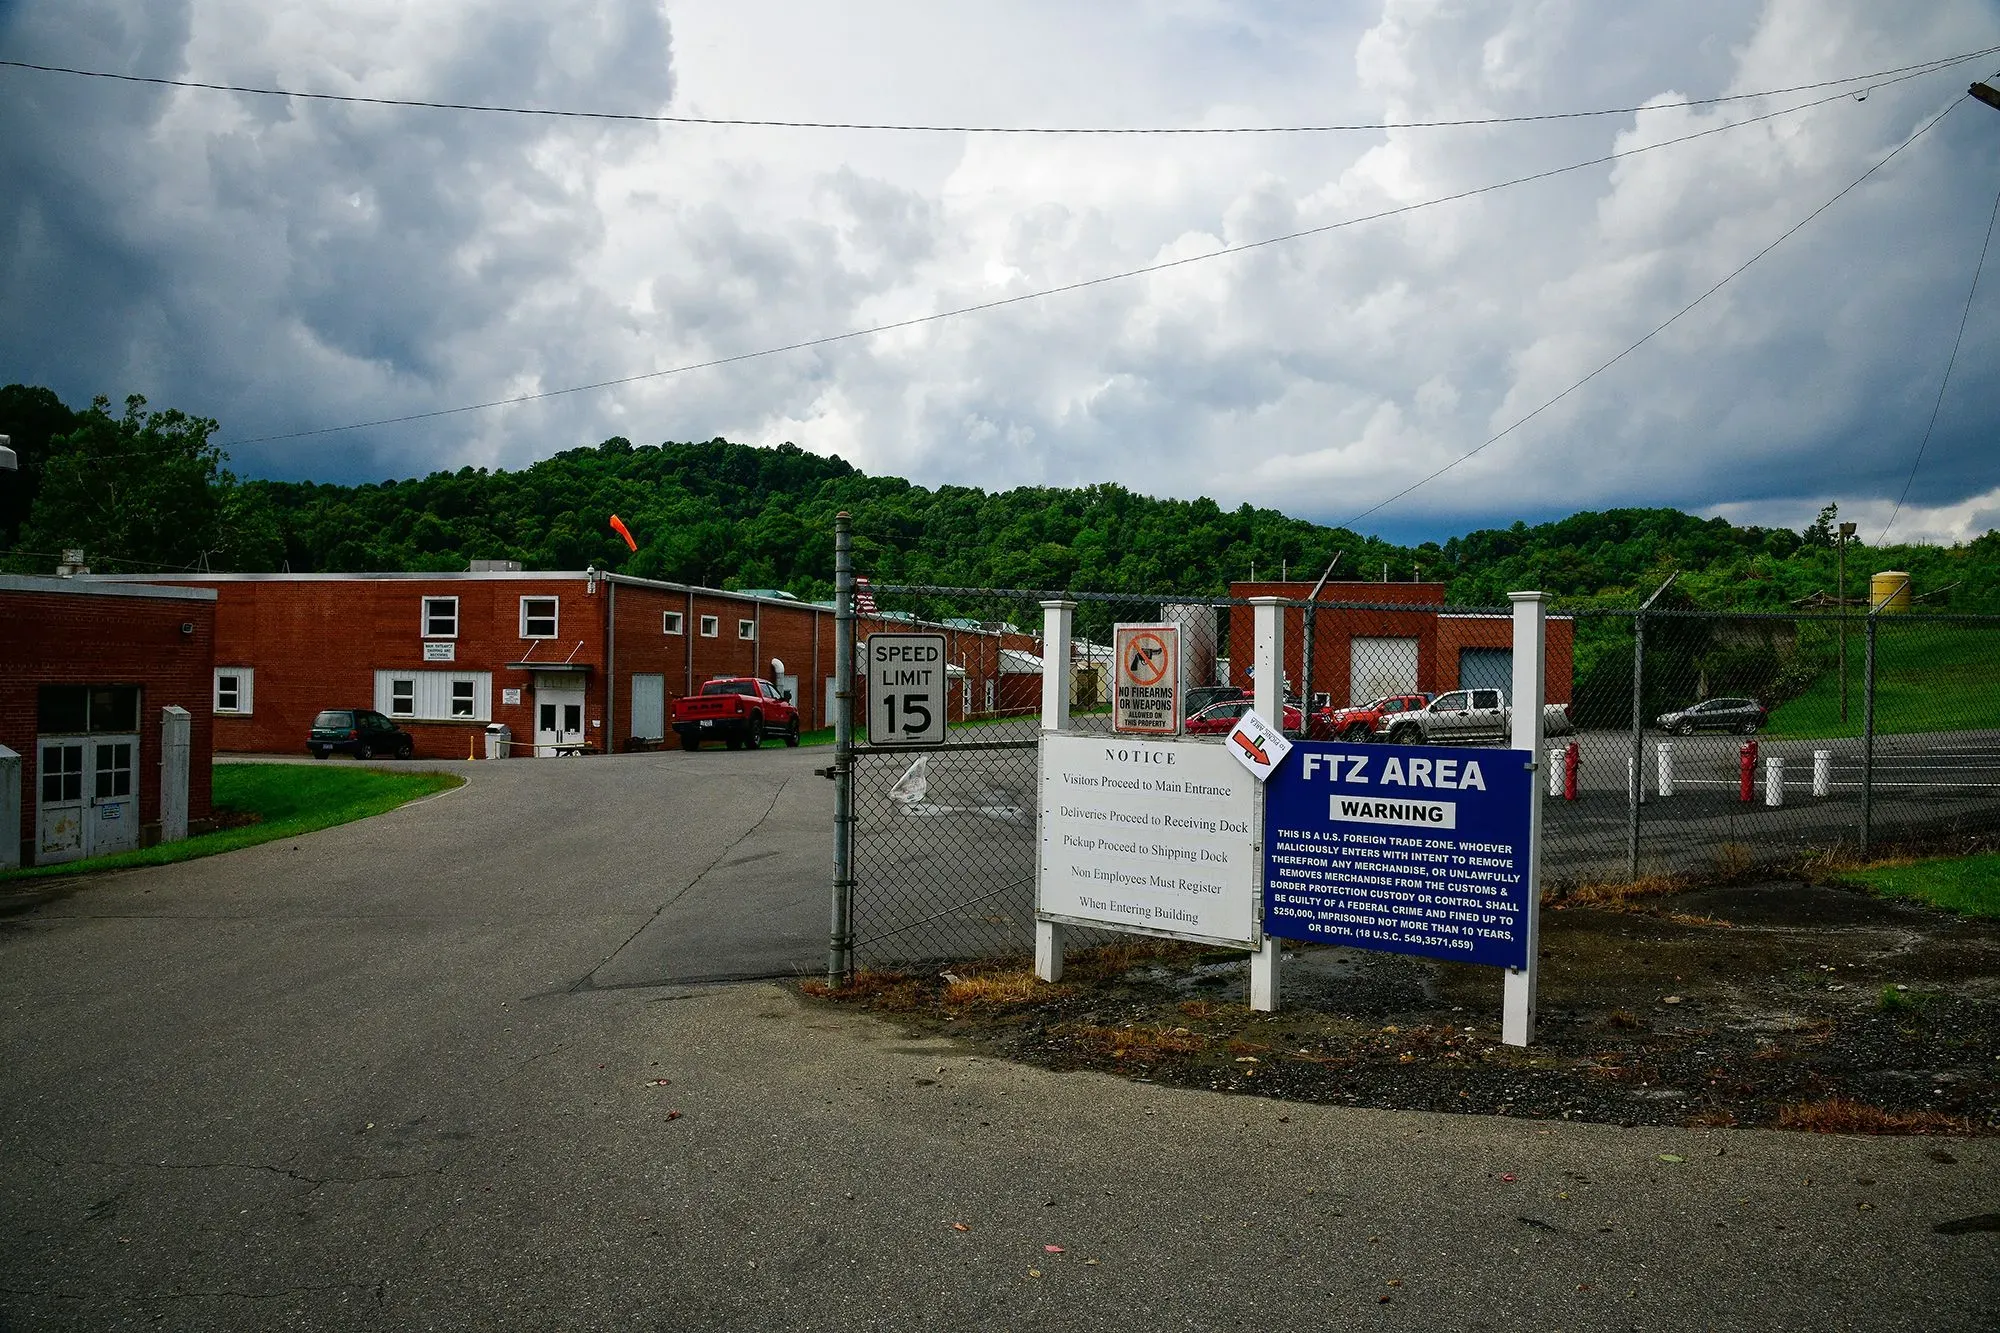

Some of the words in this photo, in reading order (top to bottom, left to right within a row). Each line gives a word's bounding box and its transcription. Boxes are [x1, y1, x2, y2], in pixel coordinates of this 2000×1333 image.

[876, 646, 938, 661] SPEED
[883, 670, 932, 685] LIMIT
[1119, 687, 1129, 697] NO
[1132, 687, 1173, 698] FIREARMS
[1120, 699, 1131, 709] OR
[1132, 700, 1172, 711] WEAPONS
[884, 694, 931, 733] 15
[1250, 717, 1265, 731] AREA
[1262, 728, 1281, 746] PICNIC
[1105, 749, 1175, 765] NOTICE
[1063, 773, 1099, 787] Visitors
[1101, 776, 1140, 790] Proceed
[1142, 780, 1152, 790] to
[1155, 780, 1181, 793] Main
[1185, 783, 1231, 796] Entrance
[1303, 753, 1369, 783] FTZ
[1380, 757, 1487, 791] AREA
[1060, 806, 1107, 820] Deliveries
[1110, 810, 1149, 825] Proceed
[1151, 814, 1161, 825] to
[1164, 815, 1216, 833] Receiving
[1219, 820, 1248, 833] Dock
[1341, 801, 1443, 822] WARNING
[1063, 835, 1095, 850] Pickup
[1098, 838, 1136, 853] Proceed
[1139, 843, 1149, 854] to
[1151, 845, 1197, 863] Shipping
[1200, 849, 1228, 863] Dock
[1276, 842, 1339, 854] MALICIOUSLY
[1342, 847, 1380, 858] ENTERS
[1382, 850, 1408, 860] WITH
[1411, 853, 1449, 863] INTENT
[1452, 856, 1466, 864] TO
[1469, 857, 1513, 868] REMOVE
[1278, 829, 1299, 838] THIS
[1302, 831, 1311, 839] IS
[1314, 832, 1320, 840] A
[1323, 833, 1340, 841] U.S.
[1343, 834, 1386, 844] FOREIGN
[1389, 837, 1422, 847] TRADE
[1425, 840, 1456, 850] ZONE.
[1459, 842, 1512, 854] WHOEVER
[1071, 865, 1091, 878] Non
[1094, 868, 1147, 885] Employees
[1150, 875, 1175, 889] Must
[1178, 879, 1222, 894] Register
[1272, 855, 1328, 867] THEREFROM
[1332, 860, 1352, 869] ANY
[1354, 862, 1429, 877] MERCHANDISE,
[1432, 868, 1446, 877] OR
[1449, 869, 1520, 883] UNLAWFULLY
[1280, 868, 1322, 879] REMOVES
[1325, 872, 1392, 886] MERCHANDISE
[1395, 878, 1422, 888] FROM
[1425, 881, 1445, 891] THE
[1448, 883, 1497, 896] CUSTOMS
[1500, 888, 1508, 896] &
[1270, 881, 1306, 891] BORDER
[1309, 884, 1367, 897] PROTECTION
[1370, 890, 1415, 901] CUSTODY
[1418, 895, 1432, 903] OR
[1435, 896, 1483, 908] CONTROL
[1486, 901, 1519, 912] SHALL
[1274, 894, 1286, 902] BE
[1288, 895, 1321, 906] GUILTY
[1324, 899, 1336, 907] OF
[1347, 901, 1389, 913] FEDERAL
[1392, 906, 1423, 916] CRIME
[1425, 909, 1447, 919] AND
[1449, 911, 1479, 921] FINED
[1482, 915, 1496, 923] UP
[1499, 916, 1513, 925] TO
[1079, 896, 1107, 910] When
[1110, 900, 1151, 919] Entering
[1154, 906, 1199, 925] Building
[1273, 907, 1315, 920] $250,000,
[1318, 912, 1375, 925] IMPRISONED
[1378, 918, 1398, 927] NOT
[1400, 920, 1428, 930] MORE
[1431, 923, 1459, 934] THAN
[1462, 927, 1474, 935] 10
[1476, 928, 1514, 942] YEARS,
[1308, 923, 1322, 932] OR
[1324, 926, 1353, 936] BOTH.
[1356, 929, 1370, 938] (18
[1373, 930, 1401, 941] U.S.C.
[1404, 934, 1474, 952] 549,3571,659)
